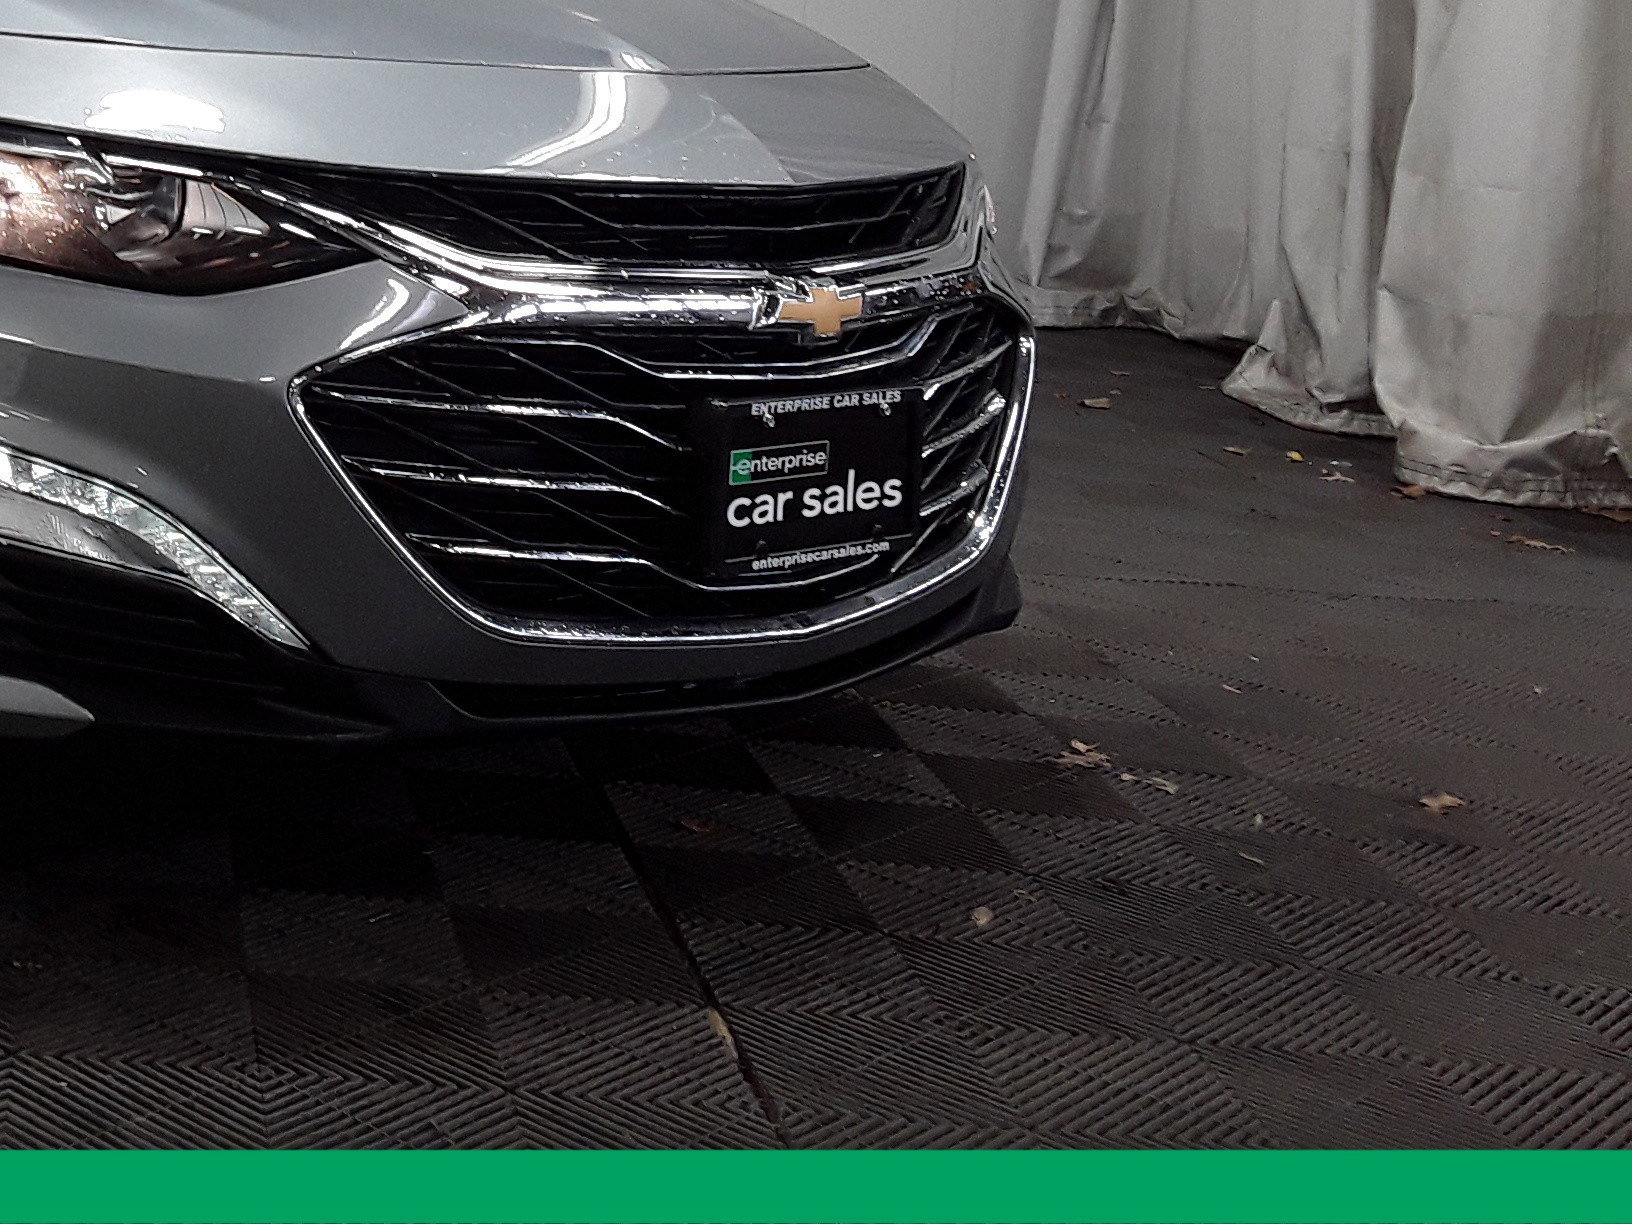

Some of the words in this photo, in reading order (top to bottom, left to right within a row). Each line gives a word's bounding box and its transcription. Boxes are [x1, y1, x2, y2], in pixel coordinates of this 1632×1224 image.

[751, 396, 831, 416] ENTERPRISE
[833, 394, 859, 408] CAR
[862, 390, 901, 405] SALES
[735, 449, 827, 475] enterprise
[726, 490, 794, 527] car
[801, 468, 903, 517] sales
[751, 541, 890, 570] enterprisecarsales.com
